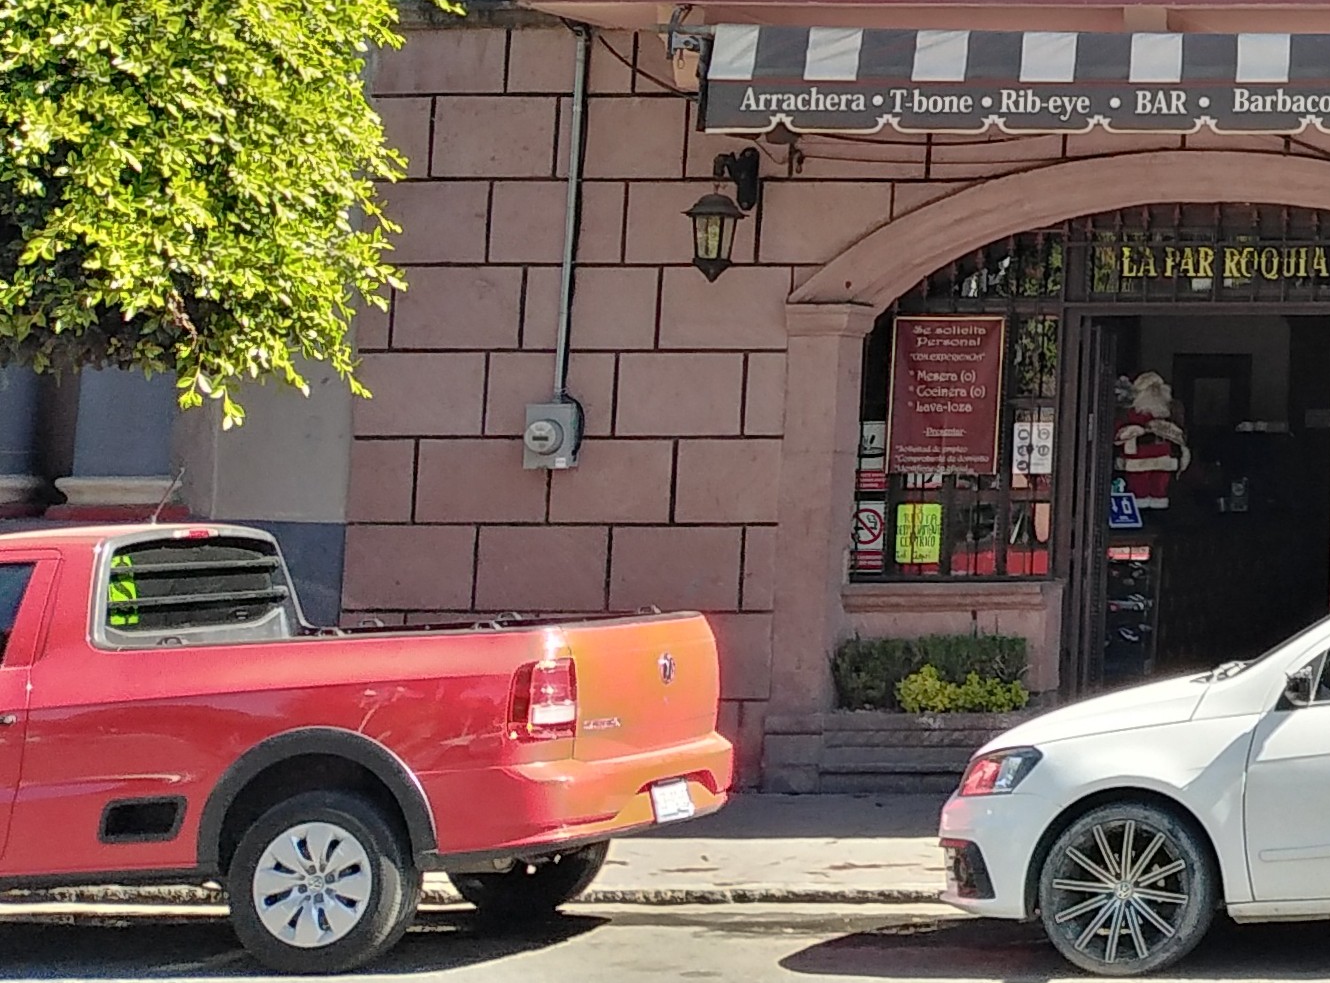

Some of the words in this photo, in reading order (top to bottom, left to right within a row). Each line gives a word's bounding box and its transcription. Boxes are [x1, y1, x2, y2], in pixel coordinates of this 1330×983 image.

[739, 86, 866, 112] Arrachera
[889, 88, 973, 113] T-bone
[1000, 88, 1090, 121] Rib-eye
[1135, 90, 1187, 115] BAR
[1121, 246, 1158, 278] LA
[916, 337, 981, 348] Personal
